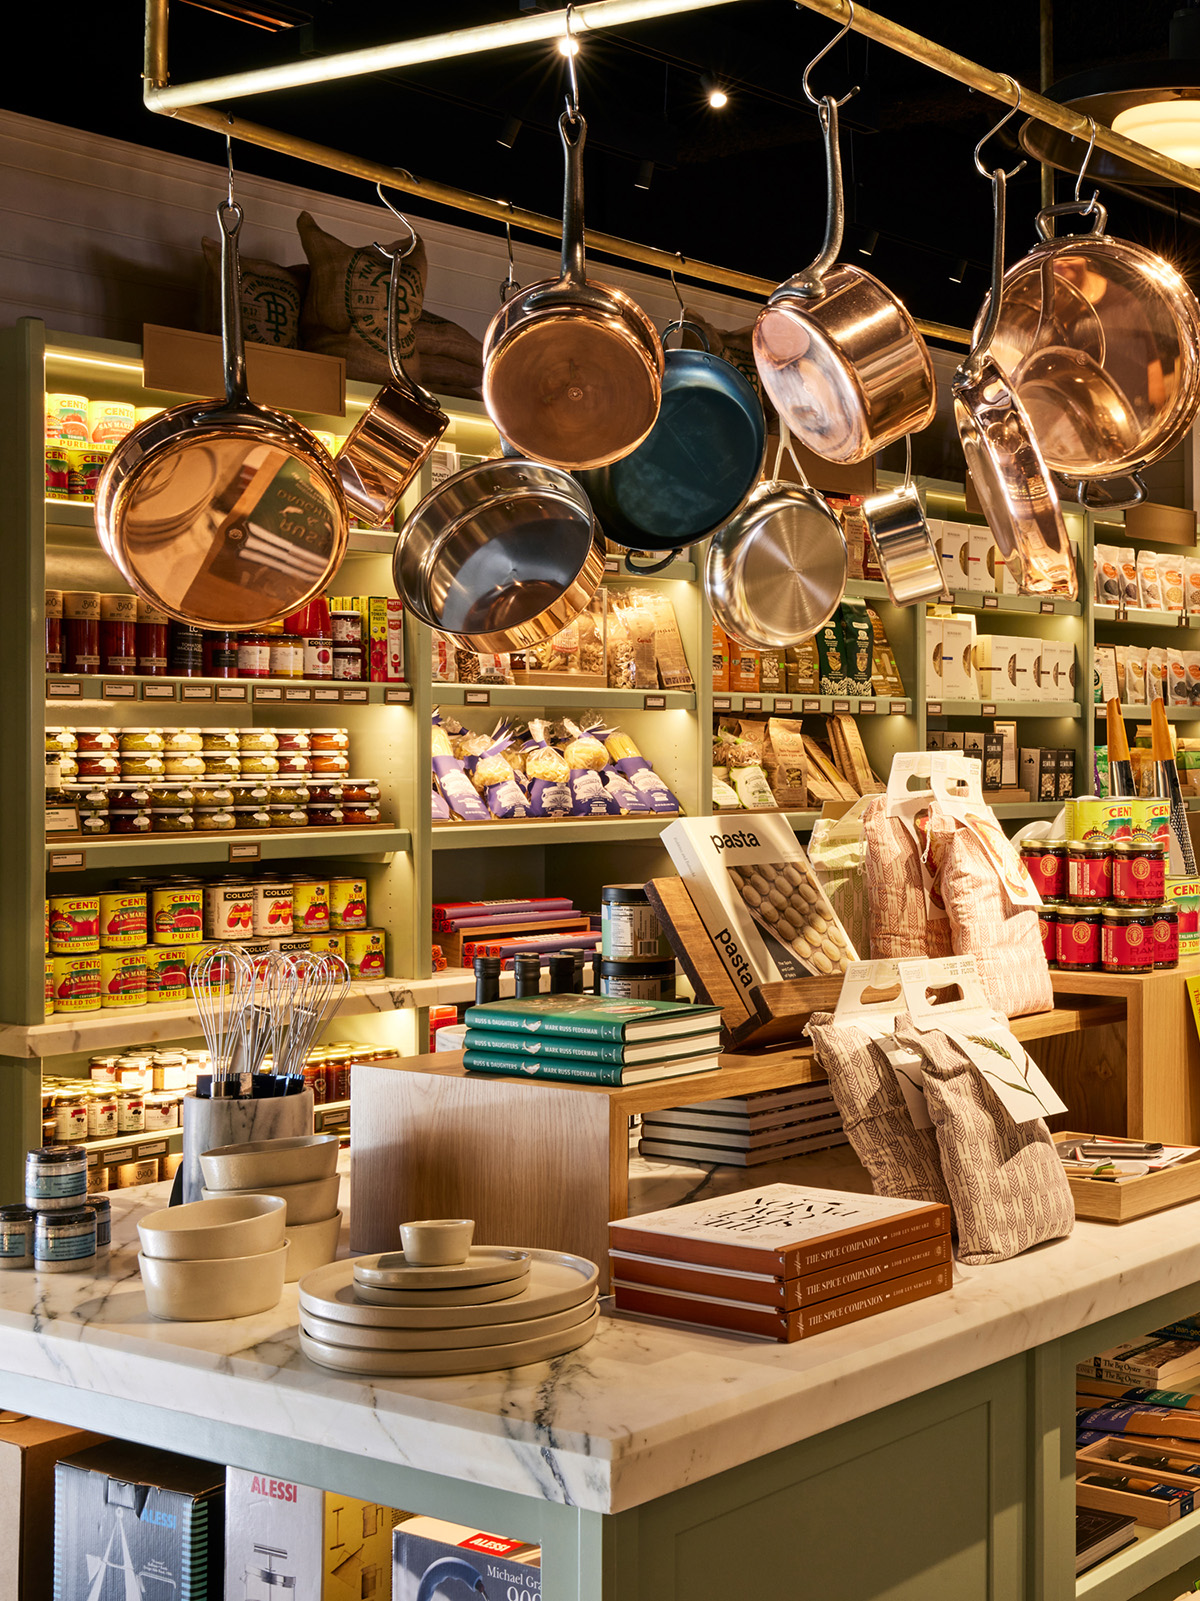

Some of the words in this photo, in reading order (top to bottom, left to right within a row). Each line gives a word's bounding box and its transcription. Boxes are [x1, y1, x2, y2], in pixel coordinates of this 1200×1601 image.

[359, 260, 376, 279] TIN
[358, 295, 375, 304] P.17
[362, 314, 375, 327] BY
[60, 400, 87, 411] CENTO
[105, 408, 133, 418] CENTO
[710, 830, 761, 854] pasta
[69, 902, 97, 910] CENTO
[159, 952, 185, 960] CENTO
[714, 928, 753, 988] pasta
[492, 1019, 519, 1027] DAUGHTERS
[573, 1026, 598, 1034] FEDERMAN
[492, 1041, 519, 1049] DAUGHTERS
[573, 1049, 598, 1057] FEDERMAN
[491, 1062, 517, 1070] DAUGHTERS
[571, 1069, 596, 1078] FEDERMAN
[805, 1255, 819, 1265] THE
[820, 1248, 841, 1261] SPICE
[841, 1236, 881, 1255] COMPANION
[806, 1285, 820, 1295] THE
[821, 1278, 842, 1292] SPICE
[842, 1265, 881, 1286] COMPANION
[808, 1316, 822, 1326] THE
[823, 1308, 844, 1322] SPICE
[844, 1295, 884, 1315] COMPANION
[1115, 1362, 1123, 1370] Big
[1124, 1364, 1141, 1373] Oyster
[1116, 1374, 1124, 1382] Big
[1125, 1376, 1141, 1385] Oyster
[251, 1475, 298, 1503] ALESSI
[141, 1508, 176, 1529] ALESSI
[469, 1538, 511, 1552] ALESSI
[487, 1565, 523, 1585] Michael
